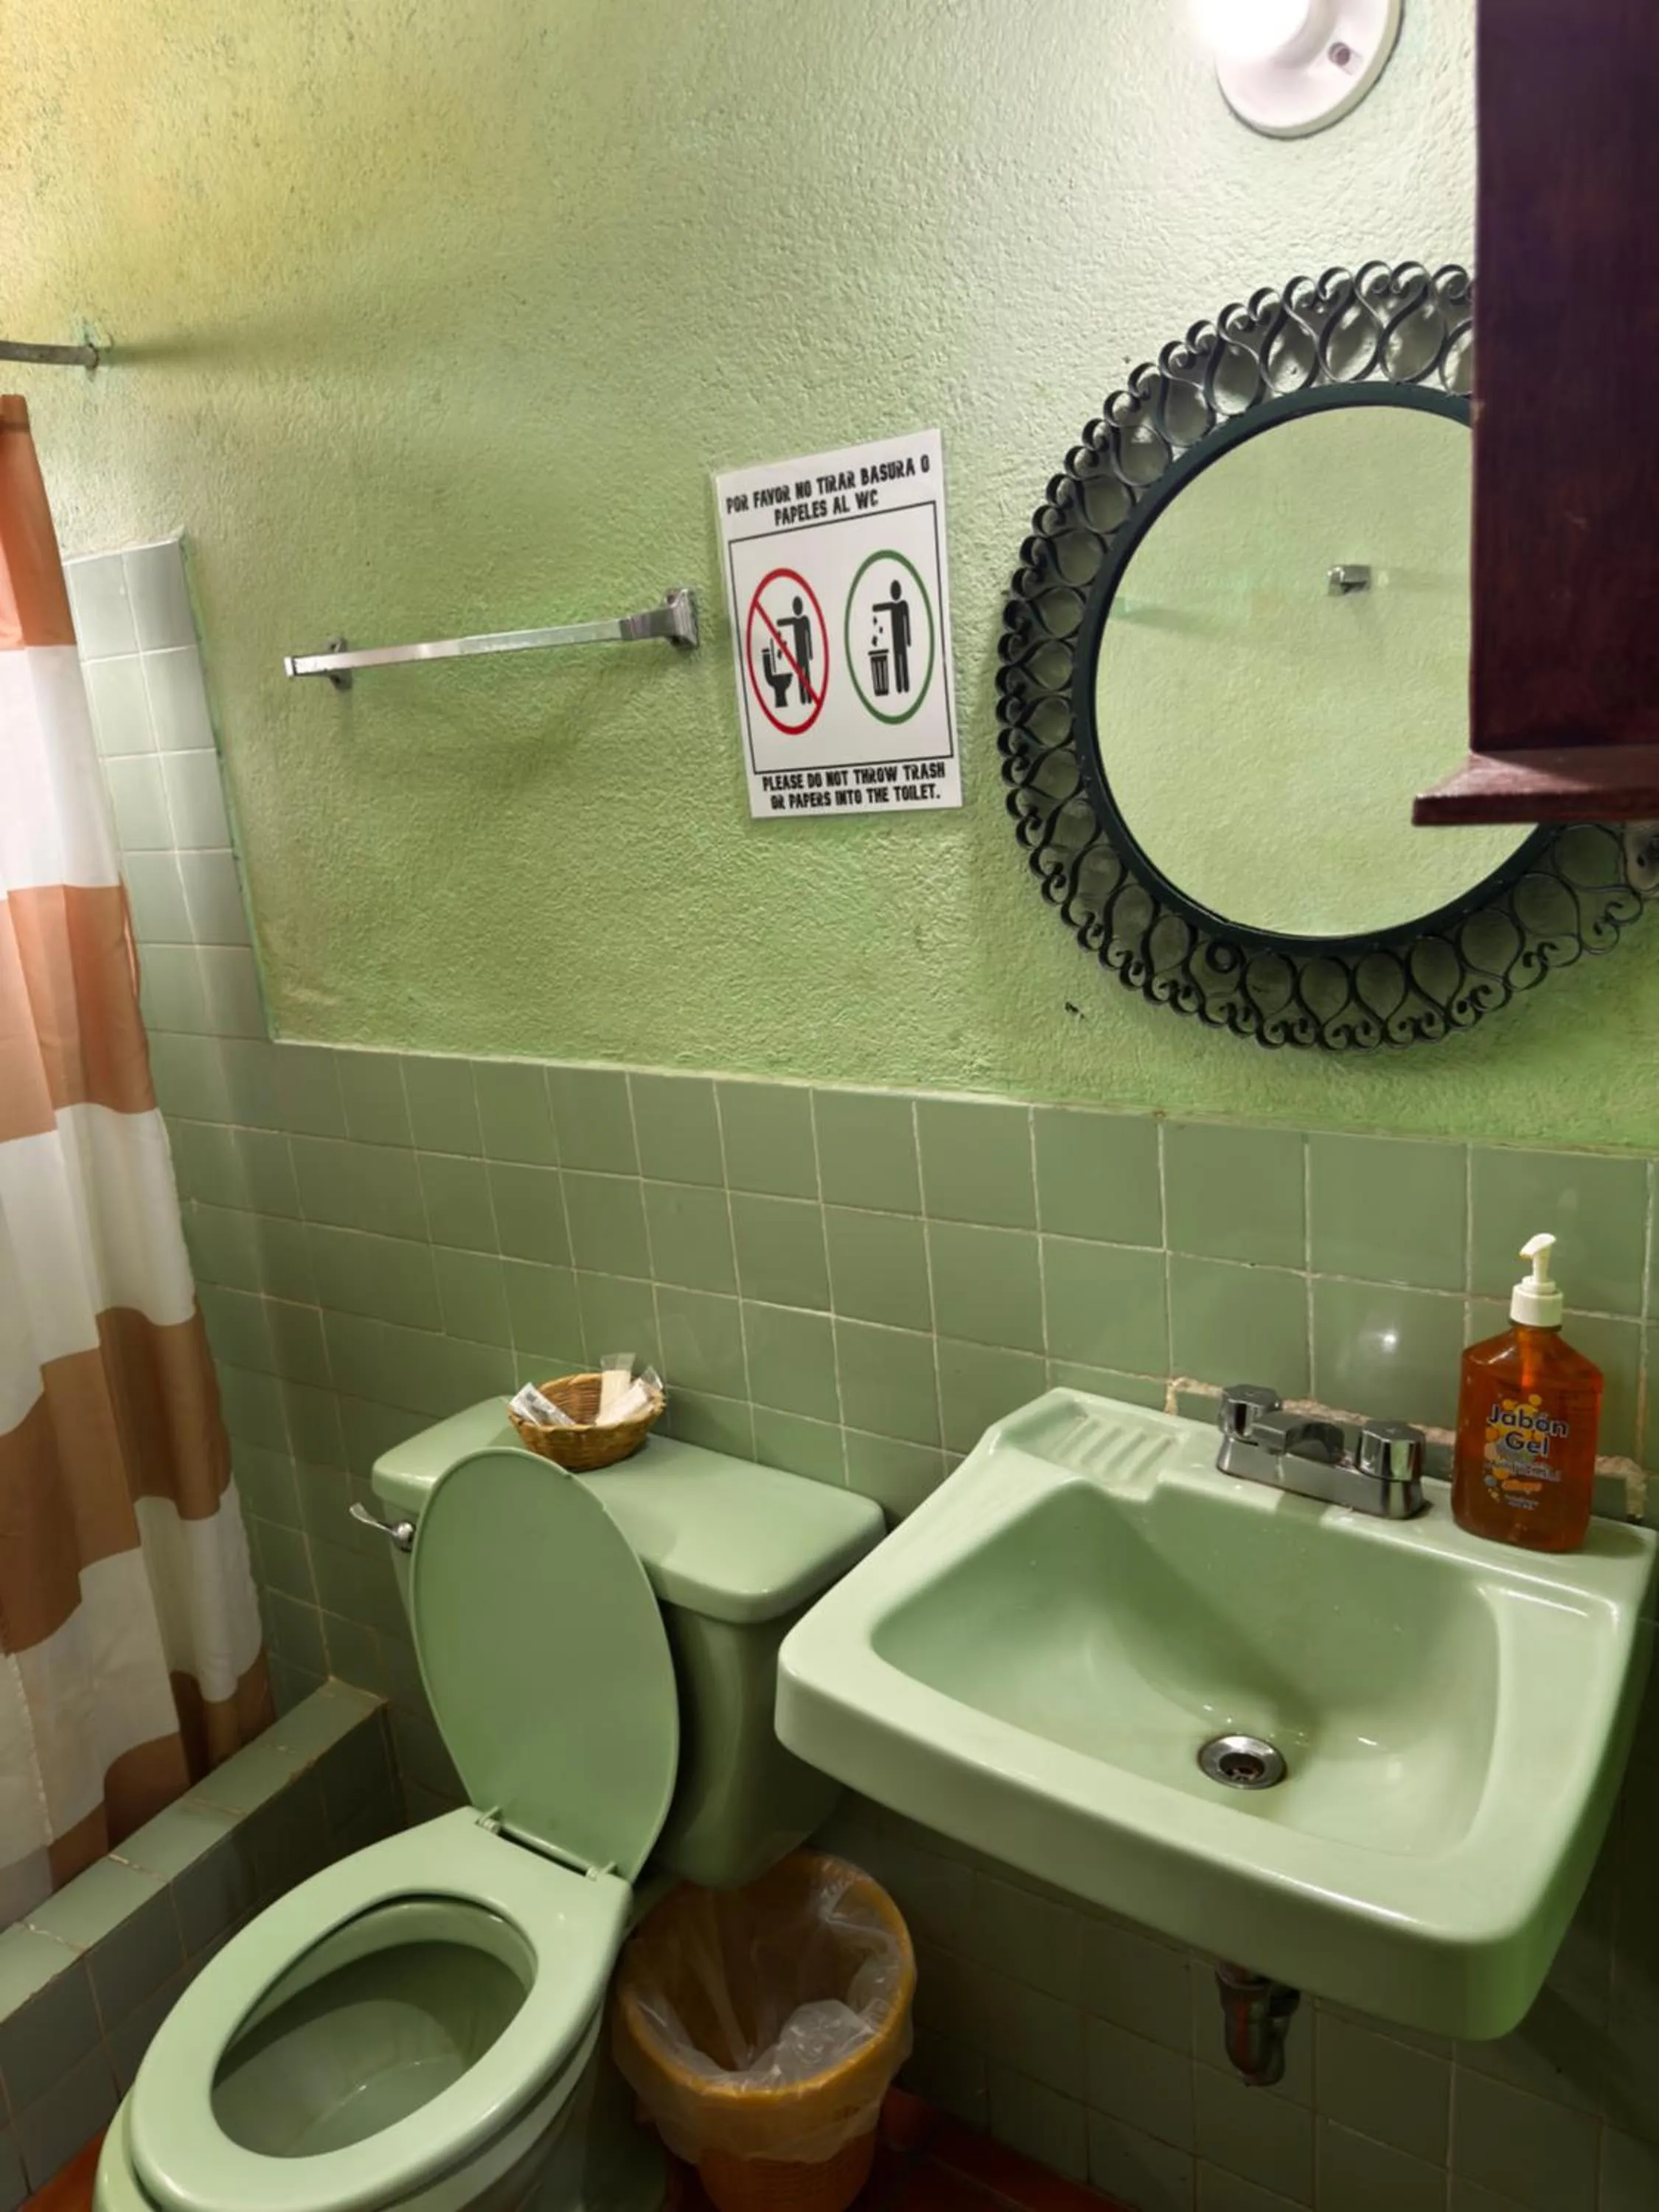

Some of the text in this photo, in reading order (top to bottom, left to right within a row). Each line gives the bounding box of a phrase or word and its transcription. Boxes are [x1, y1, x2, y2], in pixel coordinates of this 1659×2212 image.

[726, 454, 931, 515] POR FAVOR NO TIRAR BASURA O
[775, 489, 879, 526] PAPELES AL WC
[762, 762, 946, 792] PLEASE DO NOT THROW TRASH
[771, 783, 941, 810] OR PAPERS INTO THE TOILET.
[1504, 1430, 1550, 1455] Gel
